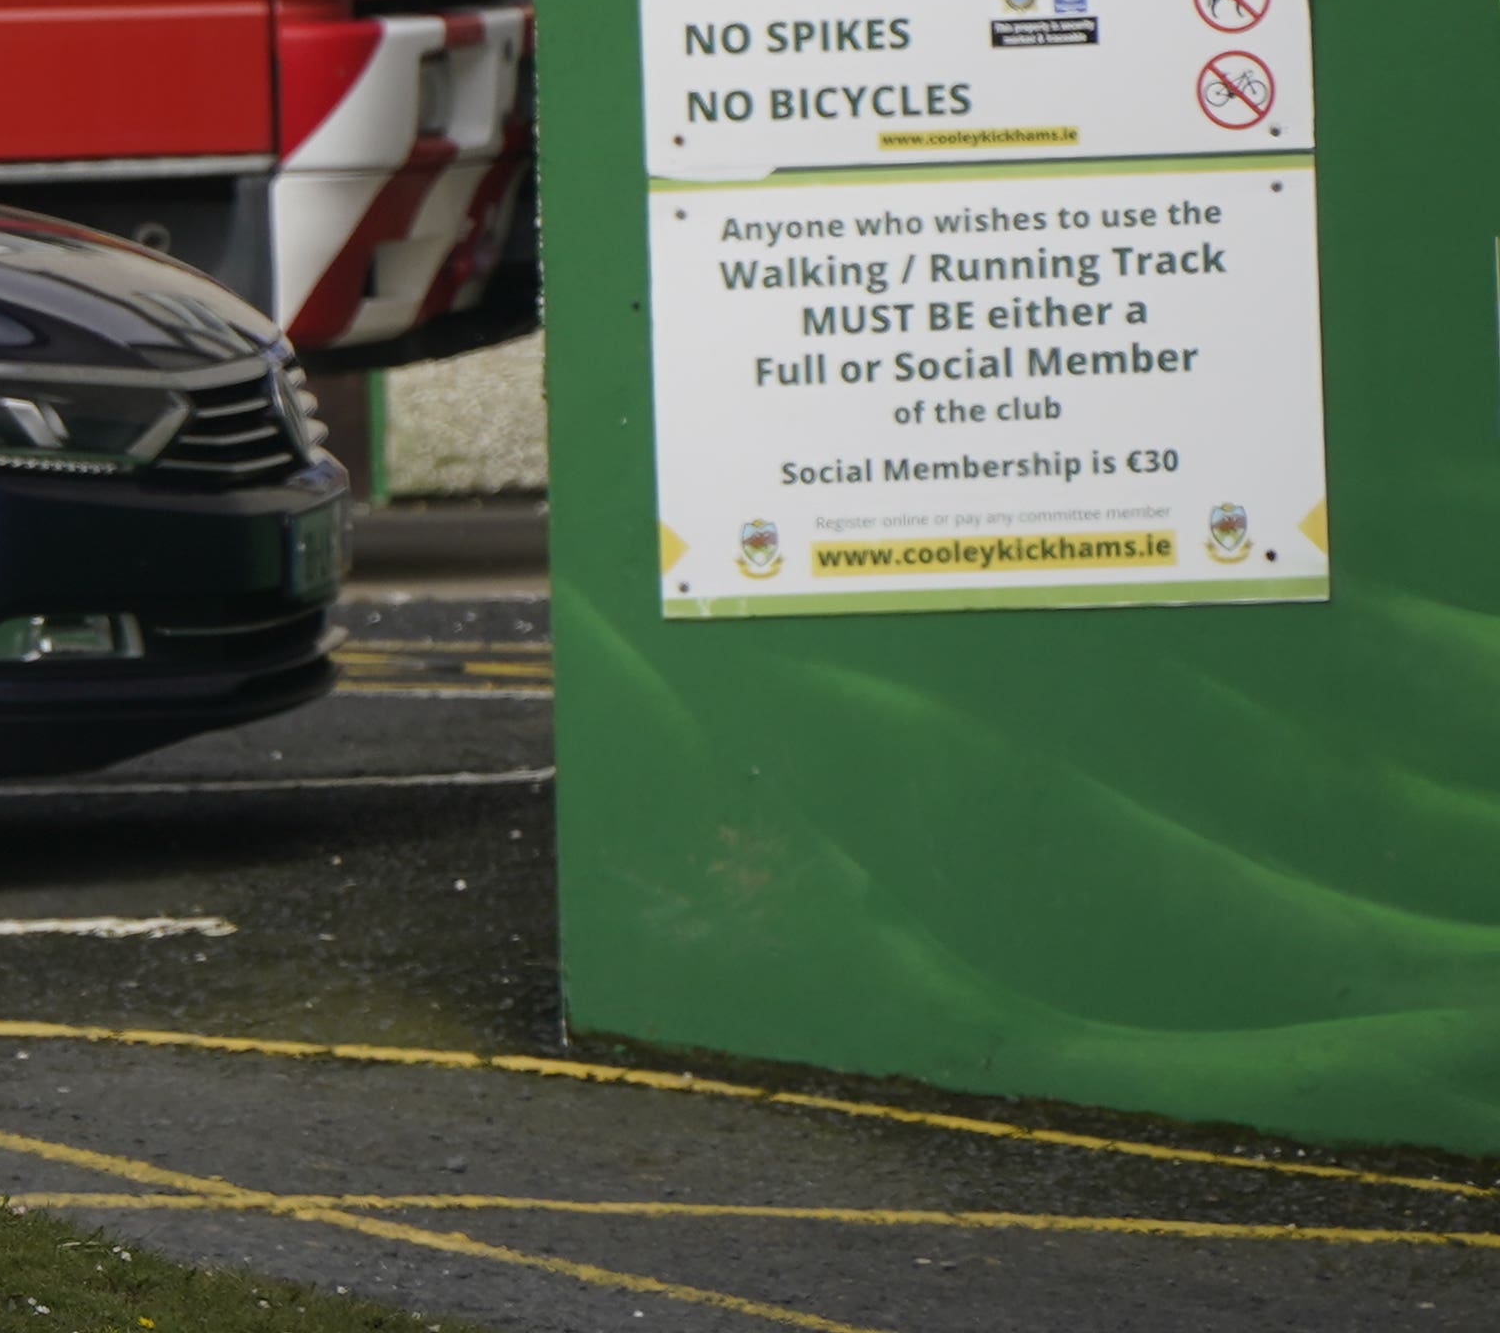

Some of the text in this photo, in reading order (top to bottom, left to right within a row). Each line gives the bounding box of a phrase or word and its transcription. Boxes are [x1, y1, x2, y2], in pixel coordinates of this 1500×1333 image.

[685, 17, 911, 55] NO SPIKES
[687, 83, 972, 122] NO BICYCLES
[880, 128, 1078, 147] www.cooleykickhams.ie
[721, 200, 1222, 247] Anyone who wishes to use the
[720, 242, 1227, 294] Walking / Running Track
[803, 296, 1149, 336] MUST BE either a
[756, 342, 1199, 387] Full or Social Member
[894, 395, 1062, 425] of the club
[782, 449, 1180, 485] Social Membership is €30
[816, 504, 1172, 533] Register online or pay any committee member
[817, 534, 1172, 569] www.cooleykickhams.ie
